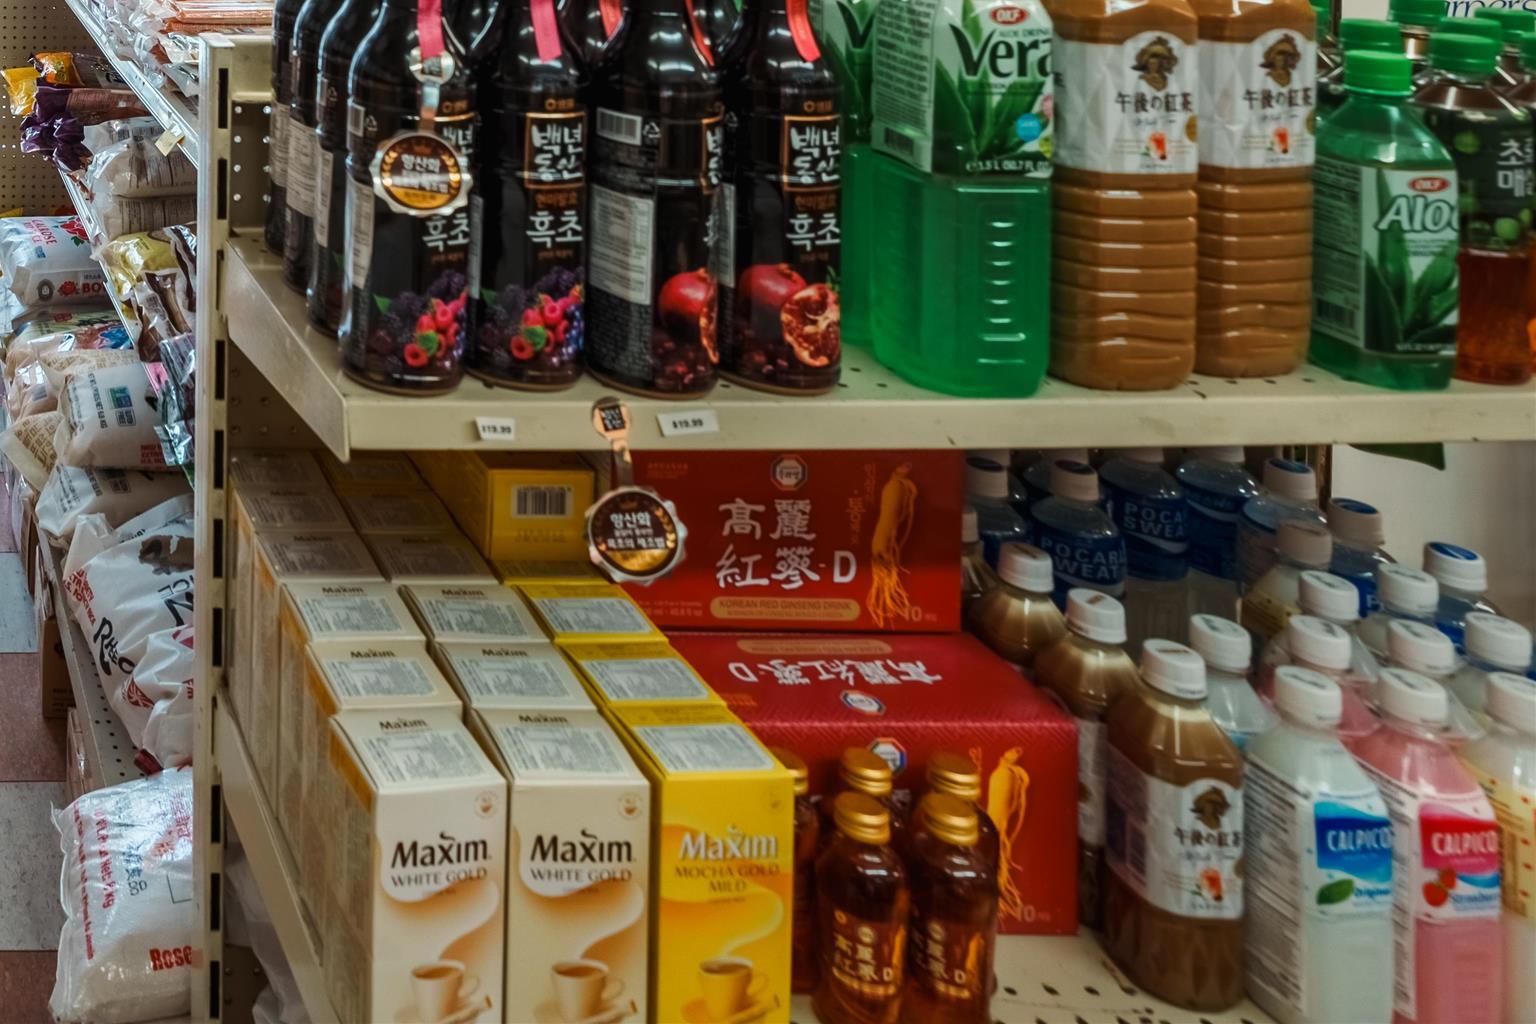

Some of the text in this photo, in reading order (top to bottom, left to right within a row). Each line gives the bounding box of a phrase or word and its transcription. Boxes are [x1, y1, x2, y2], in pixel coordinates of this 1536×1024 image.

[1115, 91, 1195, 113] 午後の紅茶
[422, 212, 470, 251] 흑초
[526, 210, 583, 248] 흑초
[785, 212, 841, 251] 흑초
[718, 497, 816, 541] 高麗
[1124, 501, 1184, 525] POCA
[1123, 516, 1184, 538] SWEA
[1054, 558, 1121, 581] WEAT
[379, 718, 427, 731] Maxim
[518, 712, 568, 725] Maxim
[390, 830, 488, 870] Maxim
[529, 828, 633, 864] Maxim
[678, 824, 778, 862] Maxim
[1327, 829, 1392, 852] CALPICO
[1432, 831, 1499, 855] CALPICO
[391, 866, 488, 888] WHITE GOLD
[529, 867, 633, 882] WHITE GOLD
[673, 863, 732, 878] MOCHA
[707, 879, 747, 893] MILD
[149, 945, 193, 972] Rose
